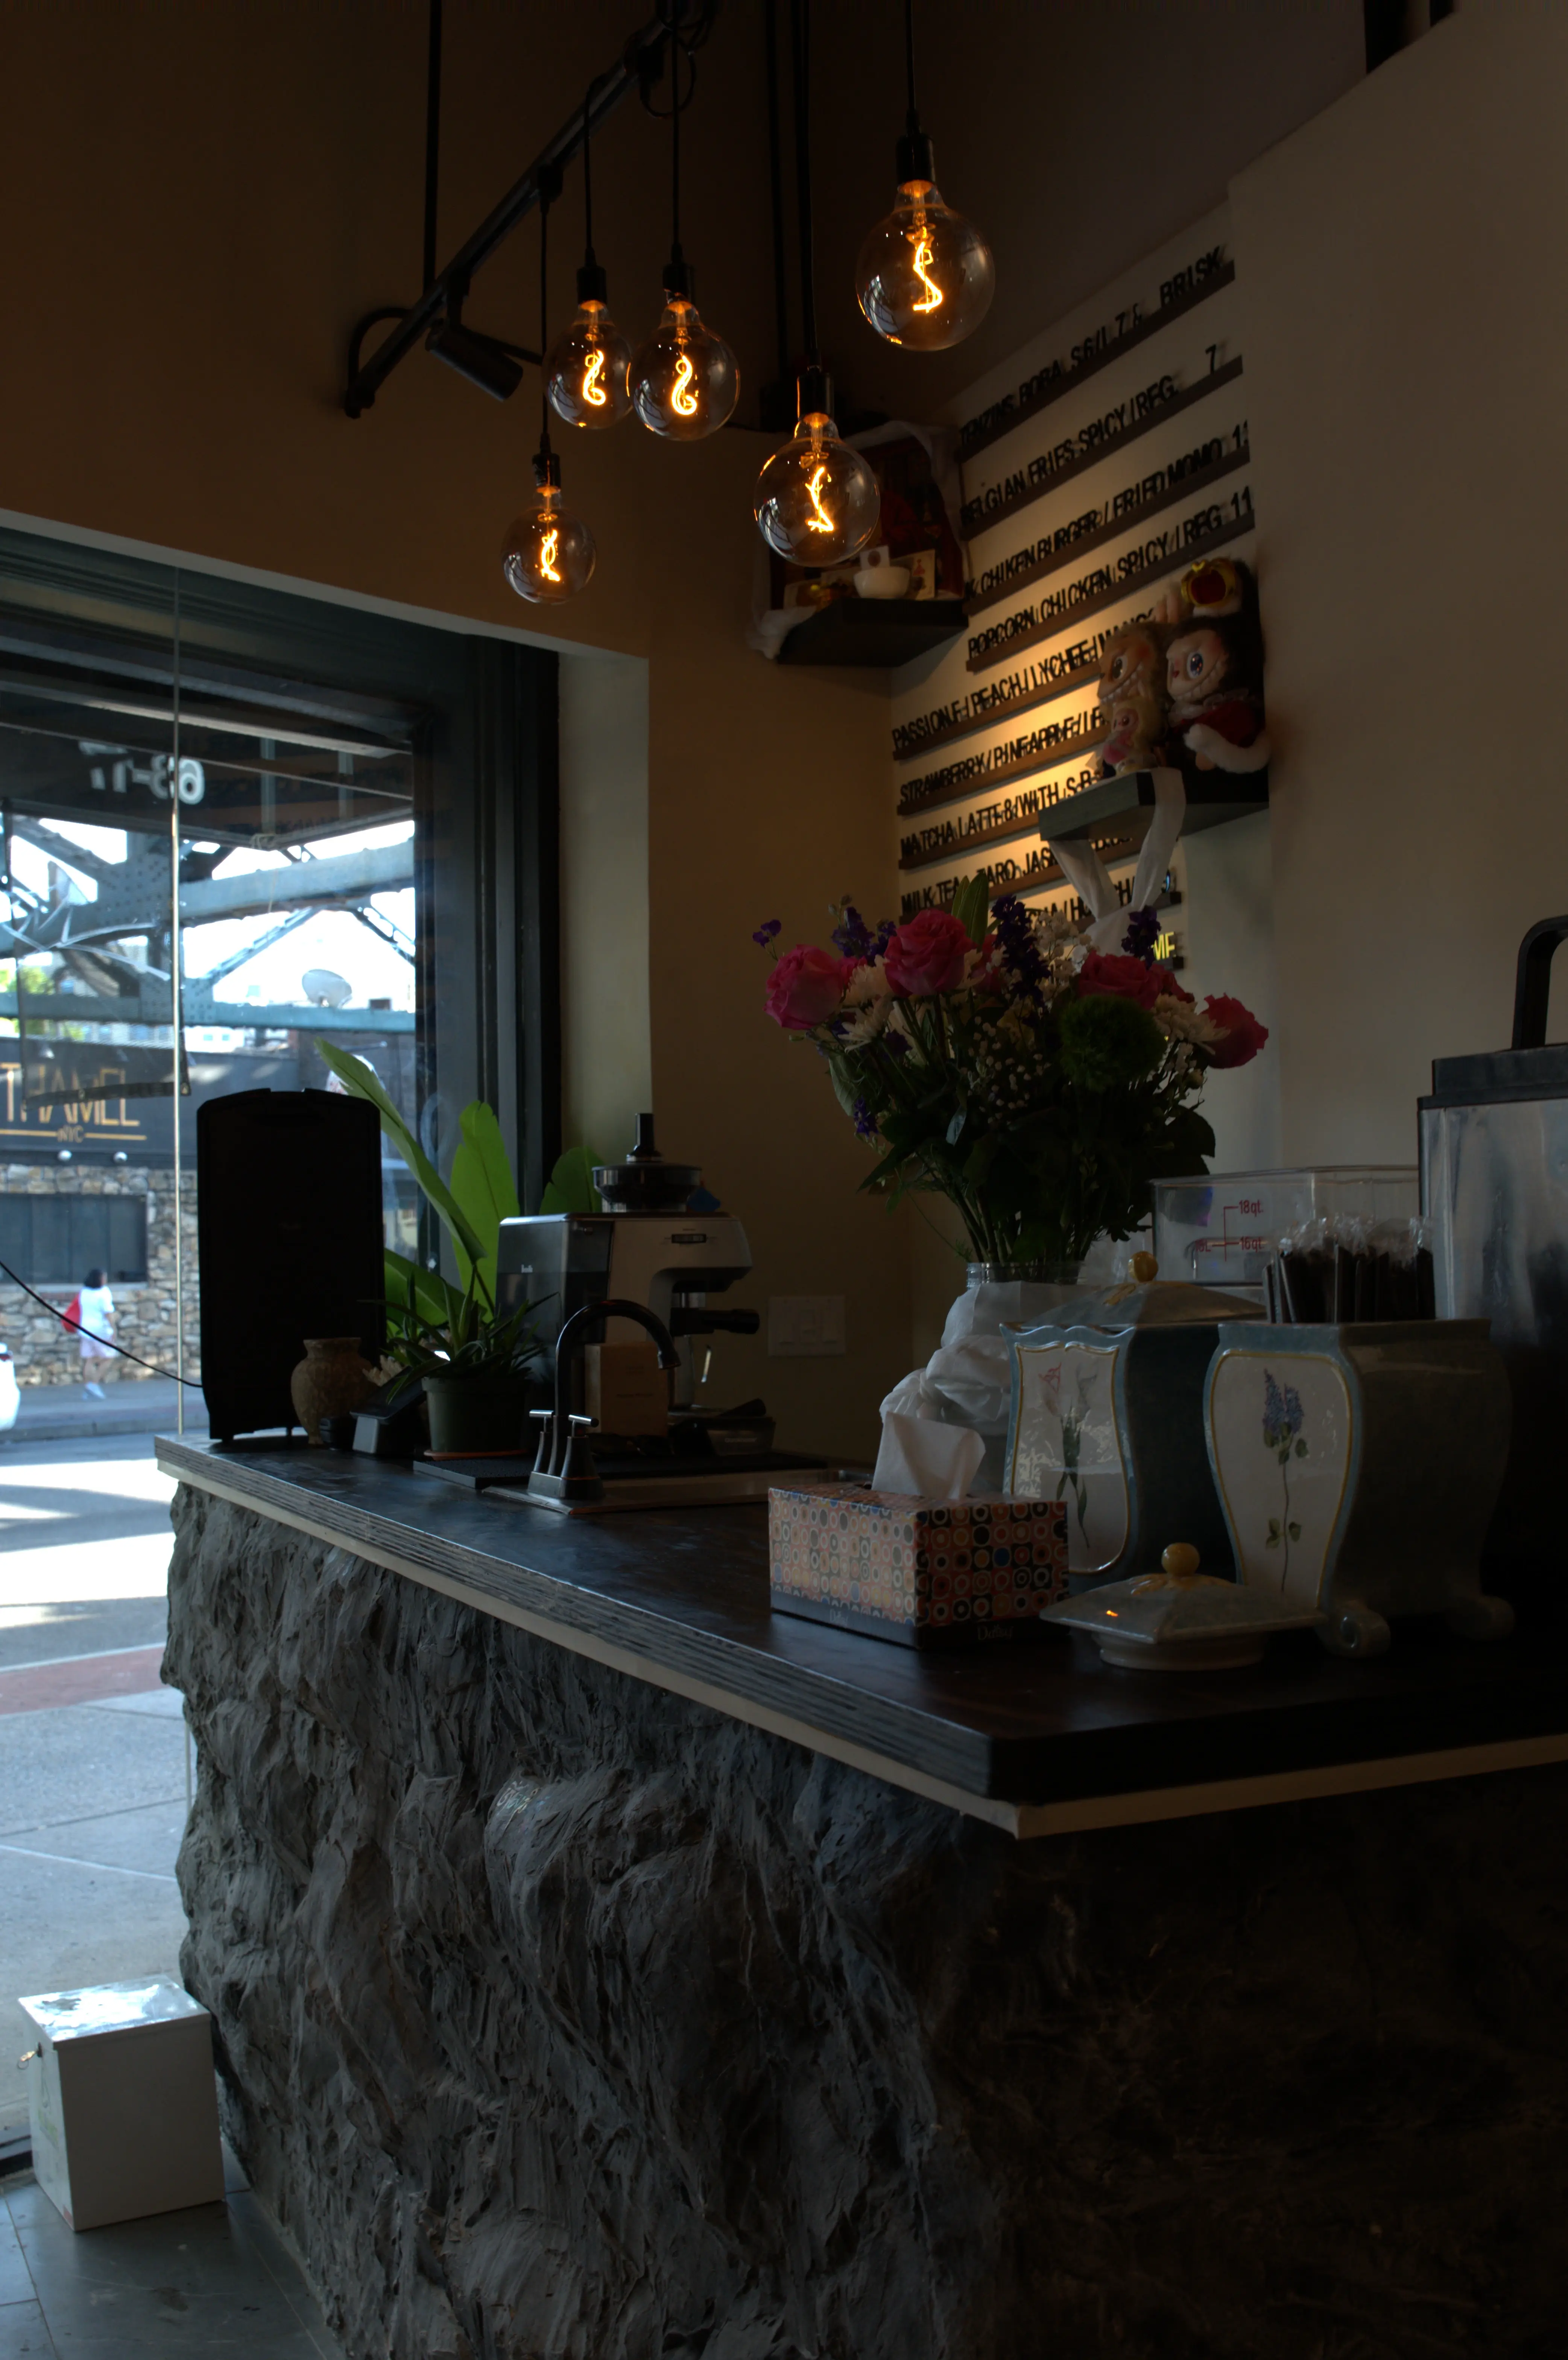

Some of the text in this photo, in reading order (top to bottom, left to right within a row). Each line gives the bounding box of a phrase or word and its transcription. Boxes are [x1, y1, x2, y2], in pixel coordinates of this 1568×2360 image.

[1019, 360, 1061, 408] BOBA
[1160, 246, 1220, 307] BRISK
[960, 470, 1026, 525] BELGIAN
[1028, 439, 1075, 486] FRIES
[1206, 344, 1216, 374] 7
[1038, 509, 1099, 562] BURGER
[1114, 471, 1165, 519] FRIED
[1168, 438, 1222, 487] MOMO
[968, 605, 1036, 660] POPCORN
[1041, 564, 1112, 622] CHICKEN
[1231, 486, 1252, 517] 11
[901, 820, 956, 859] MATCHA
[958, 802, 1001, 839] LATTE
[901, 886, 934, 913] MILK
